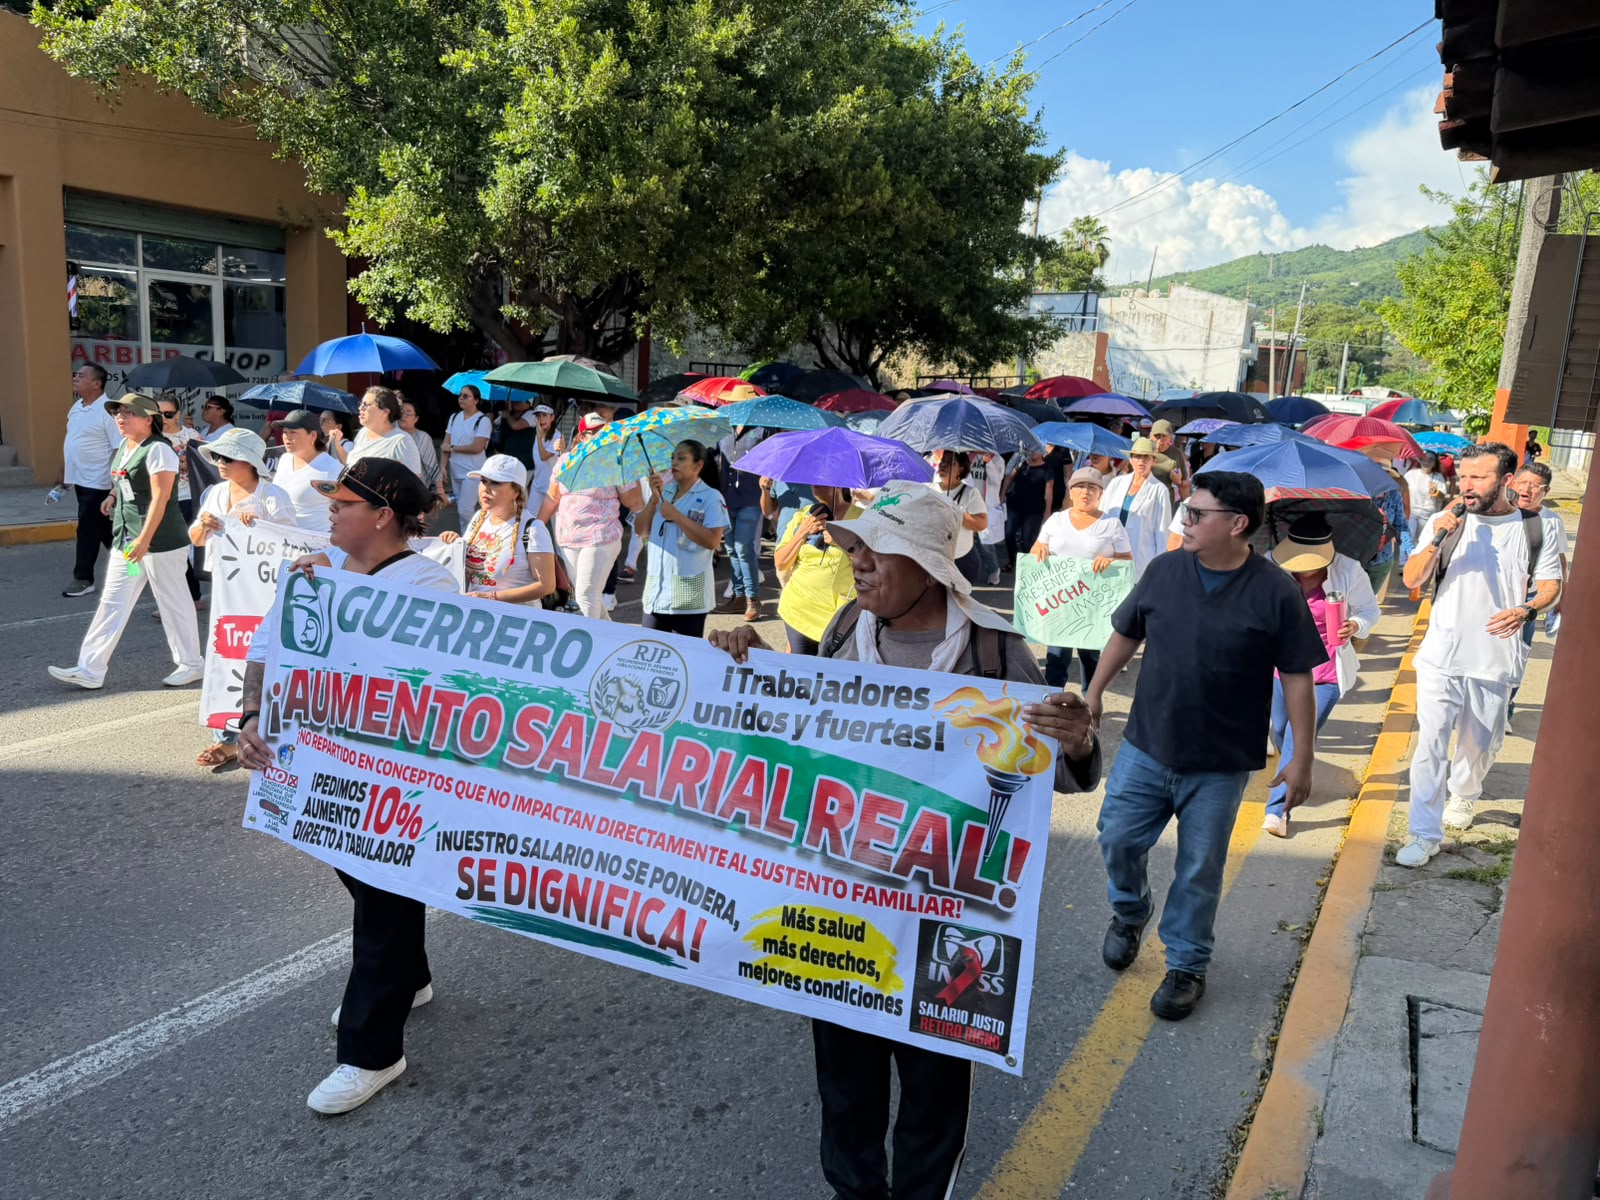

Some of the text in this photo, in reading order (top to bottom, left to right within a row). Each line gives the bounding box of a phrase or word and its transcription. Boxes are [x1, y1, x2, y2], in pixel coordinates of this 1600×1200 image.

[72, 343, 181, 365] ARBER
[246, 535, 276, 556] Los
[257, 561, 278, 583] Gu
[1017, 567, 1079, 606] PRESENTES
[1019, 557, 1076, 590] JUBILADOS
[1035, 579, 1091, 616] LUCHA
[1071, 583, 1114, 616] IMSS
[223, 622, 259, 647] Tra
[337, 585, 593, 679] GUERRERO
[632, 644, 671, 664] RJP
[722, 666, 932, 710] ¡Trabajadores
[693, 702, 946, 752] unidos y fuertes!
[265, 768, 287, 782] NO
[269, 668, 1032, 909] ¡AUMENTO SALARIAL REAL!
[311, 772, 368, 802] ¡PEDIMOS
[297, 727, 963, 919] ¡NO REPARTIDO EN CONCEPTOS QUE NO IMPACTAN DIRECTAMENTE AL SUSTENTO FAMILIAR!
[301, 796, 360, 829] AUMENTO
[362, 784, 424, 841] 10%
[293, 819, 416, 867] DIRECTO A TABULADOR
[435, 830, 740, 932] ¡NUESTRO SALARIO NO SE PONDERA,
[456, 856, 708, 963] SE DIGNIFICA!
[781, 905, 866, 943] Más salud
[763, 935, 881, 982] más derechos,
[739, 960, 904, 1016] mejores condiciones
[918, 1000, 1005, 1036] SALARIO JUSTO
[919, 1016, 1001, 1051] RETIRO DIGNO
